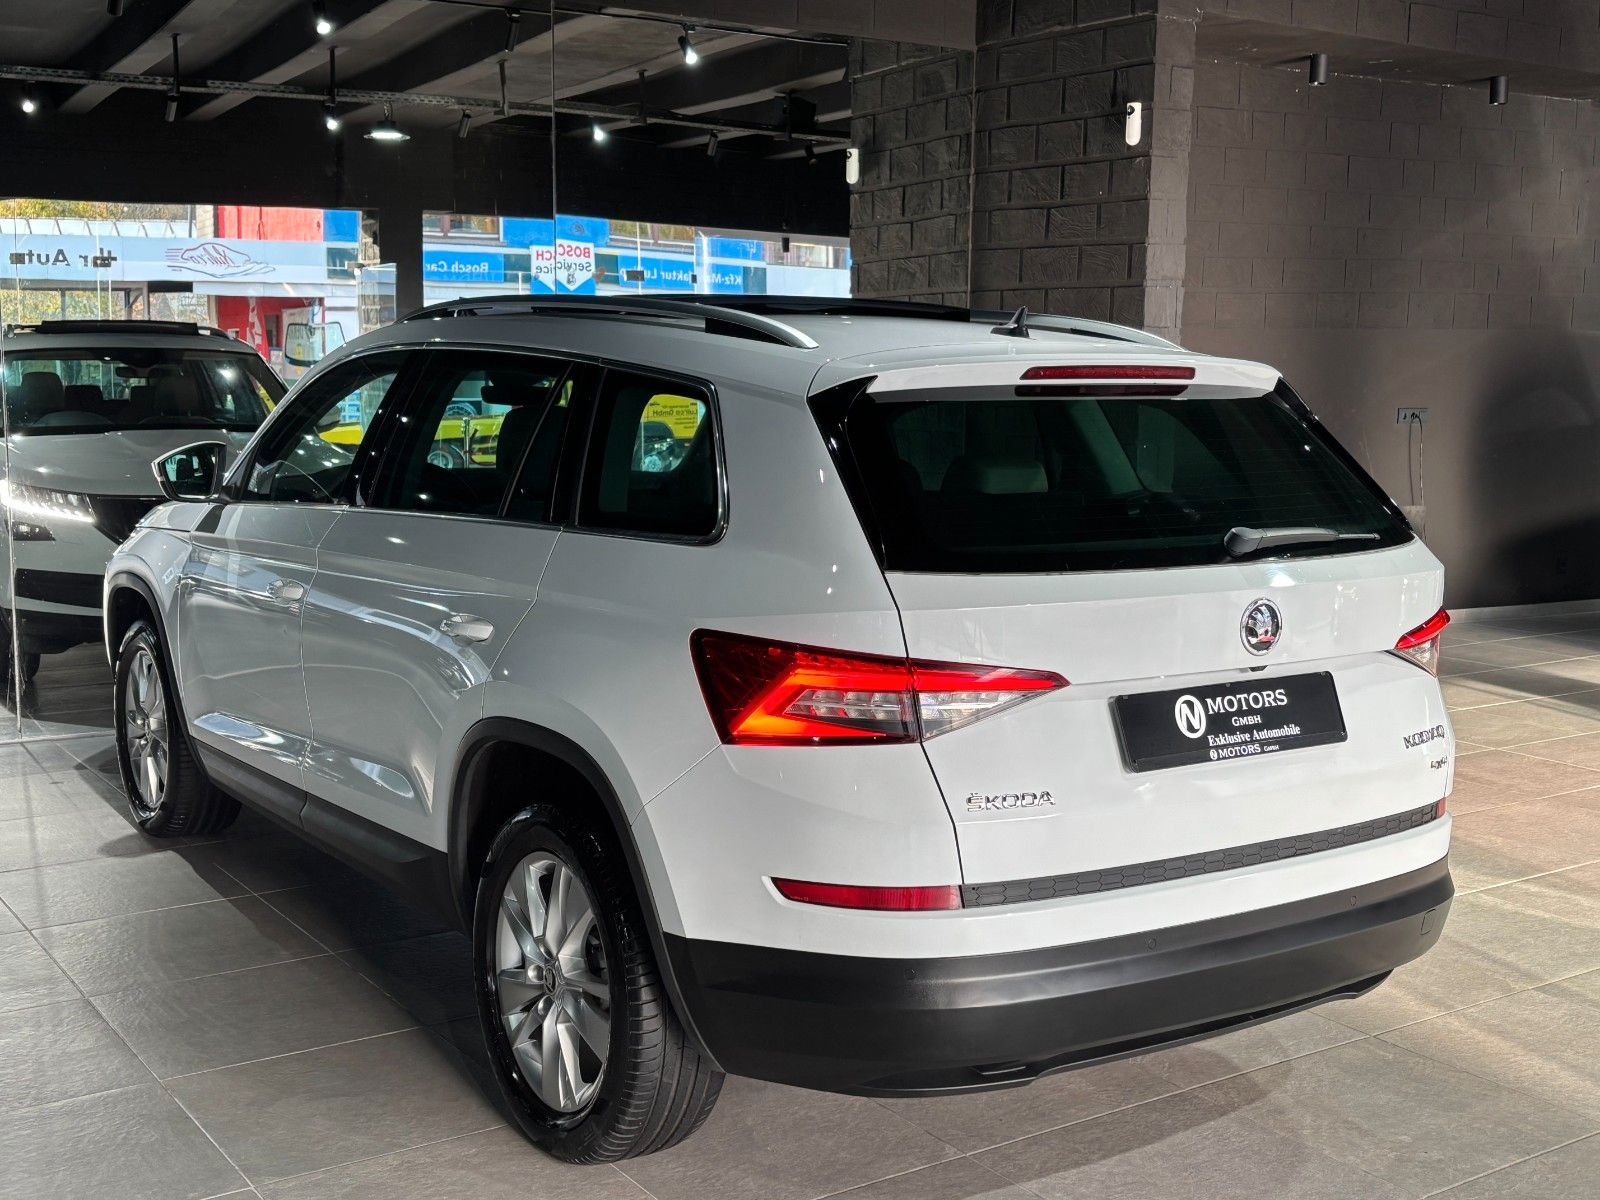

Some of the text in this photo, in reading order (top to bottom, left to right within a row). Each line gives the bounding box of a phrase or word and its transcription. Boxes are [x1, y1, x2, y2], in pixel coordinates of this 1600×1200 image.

[1205, 688, 1288, 715] MOTORS
[1207, 723, 1301, 747] Exklusive Automobile
[1218, 744, 1262, 759] MOTORS
[966, 790, 1056, 812] ŠKODA
